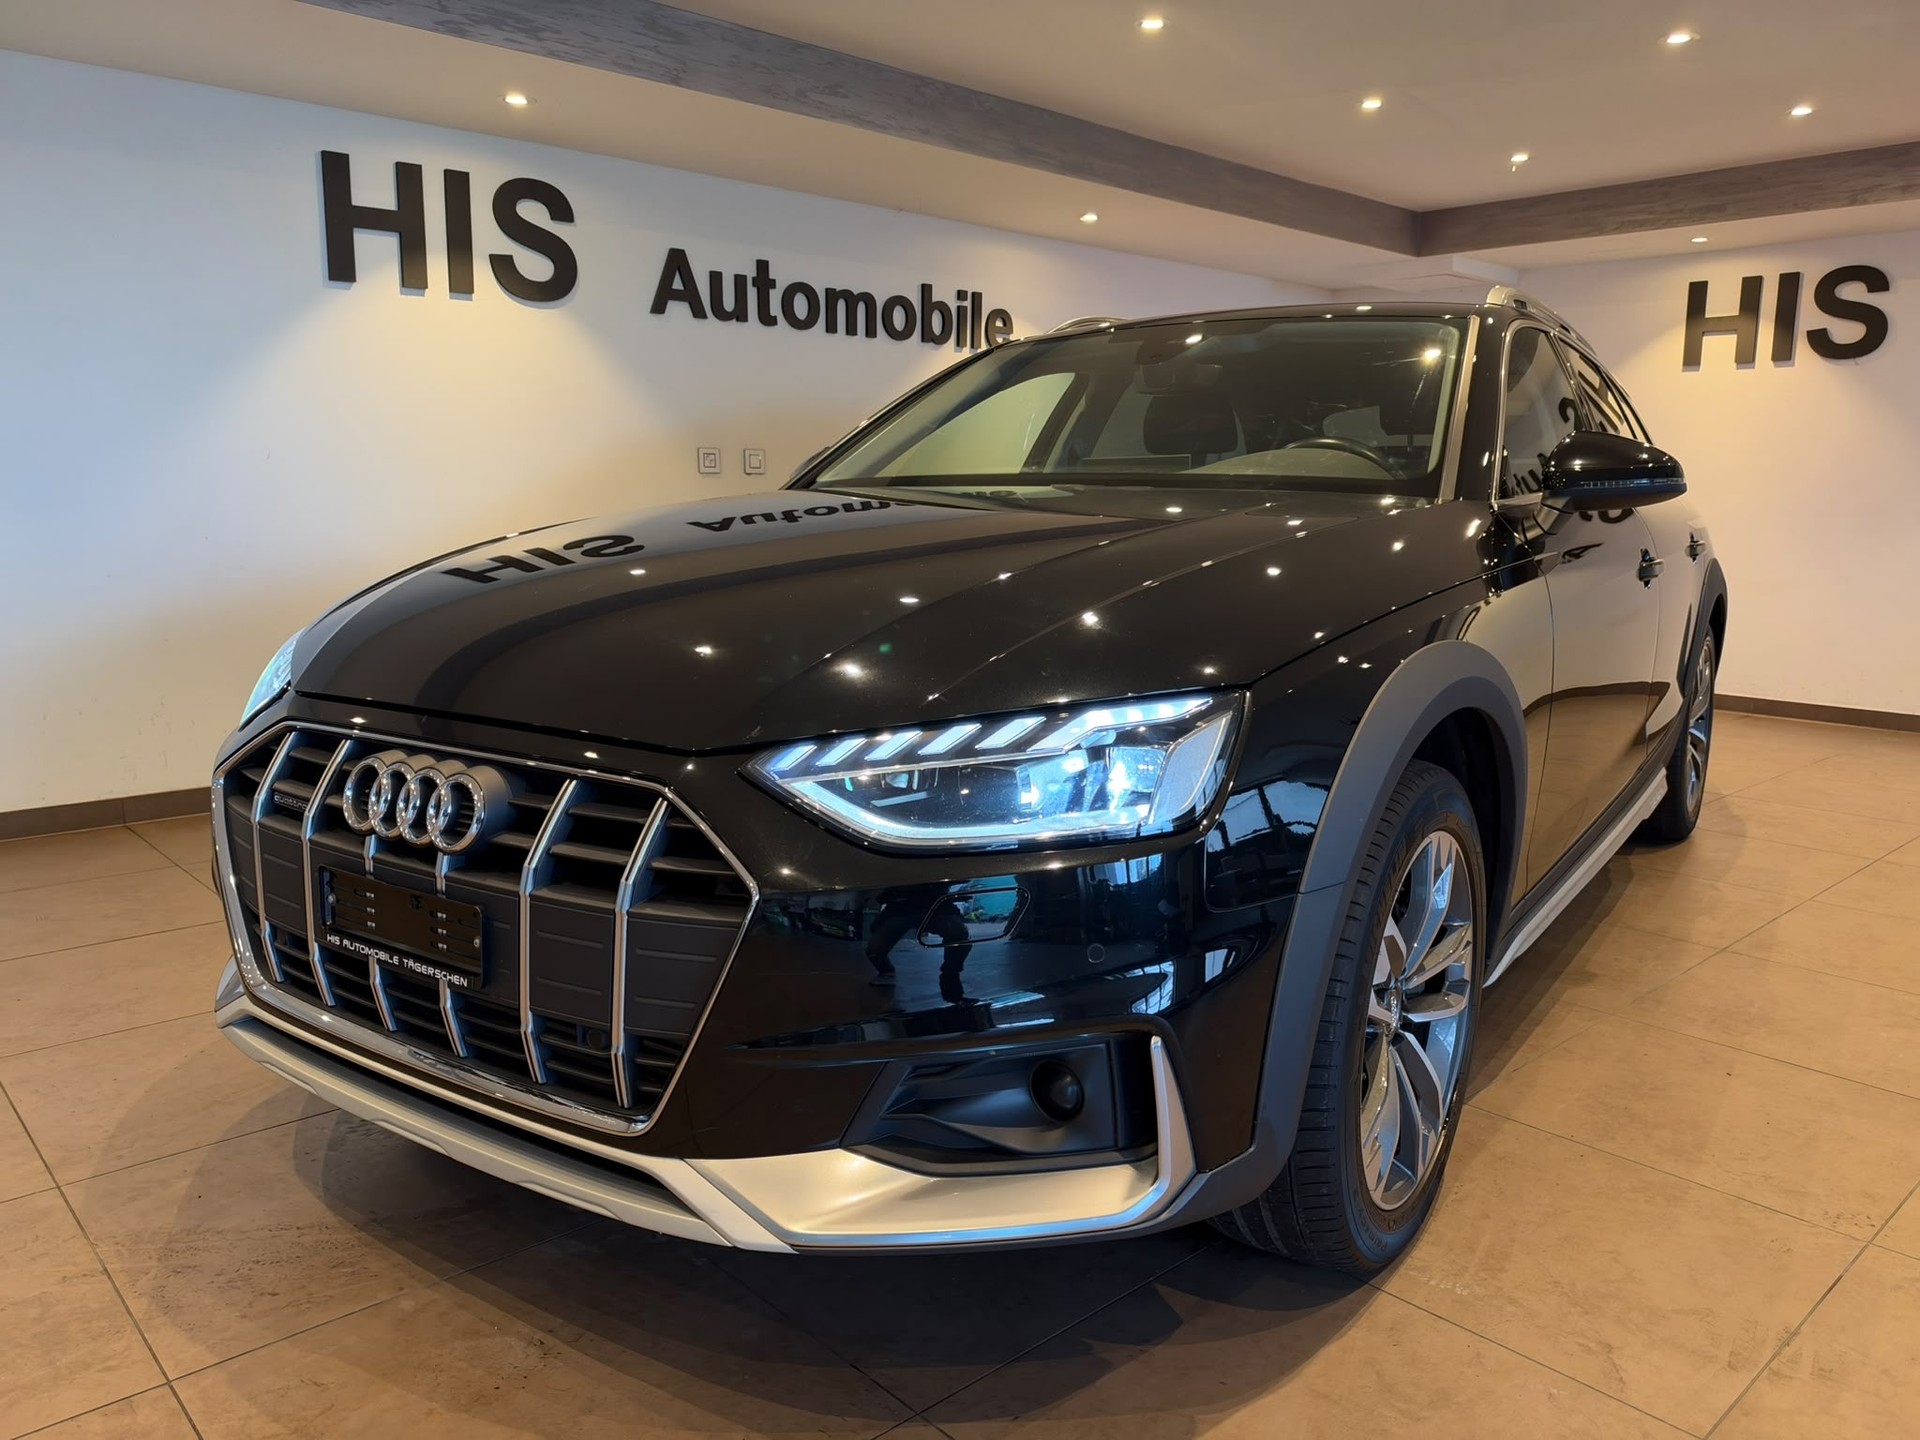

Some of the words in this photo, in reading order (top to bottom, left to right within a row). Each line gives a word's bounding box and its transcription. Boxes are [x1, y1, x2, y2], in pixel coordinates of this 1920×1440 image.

[320, 149, 578, 303] HIS
[650, 247, 1014, 350] Automobile
[1682, 264, 1890, 367] HIS
[326, 933, 341, 945] HIS
[342, 938, 399, 966] AUTOMOBILE
[402, 958, 468, 987] TÄGERSCHEN
